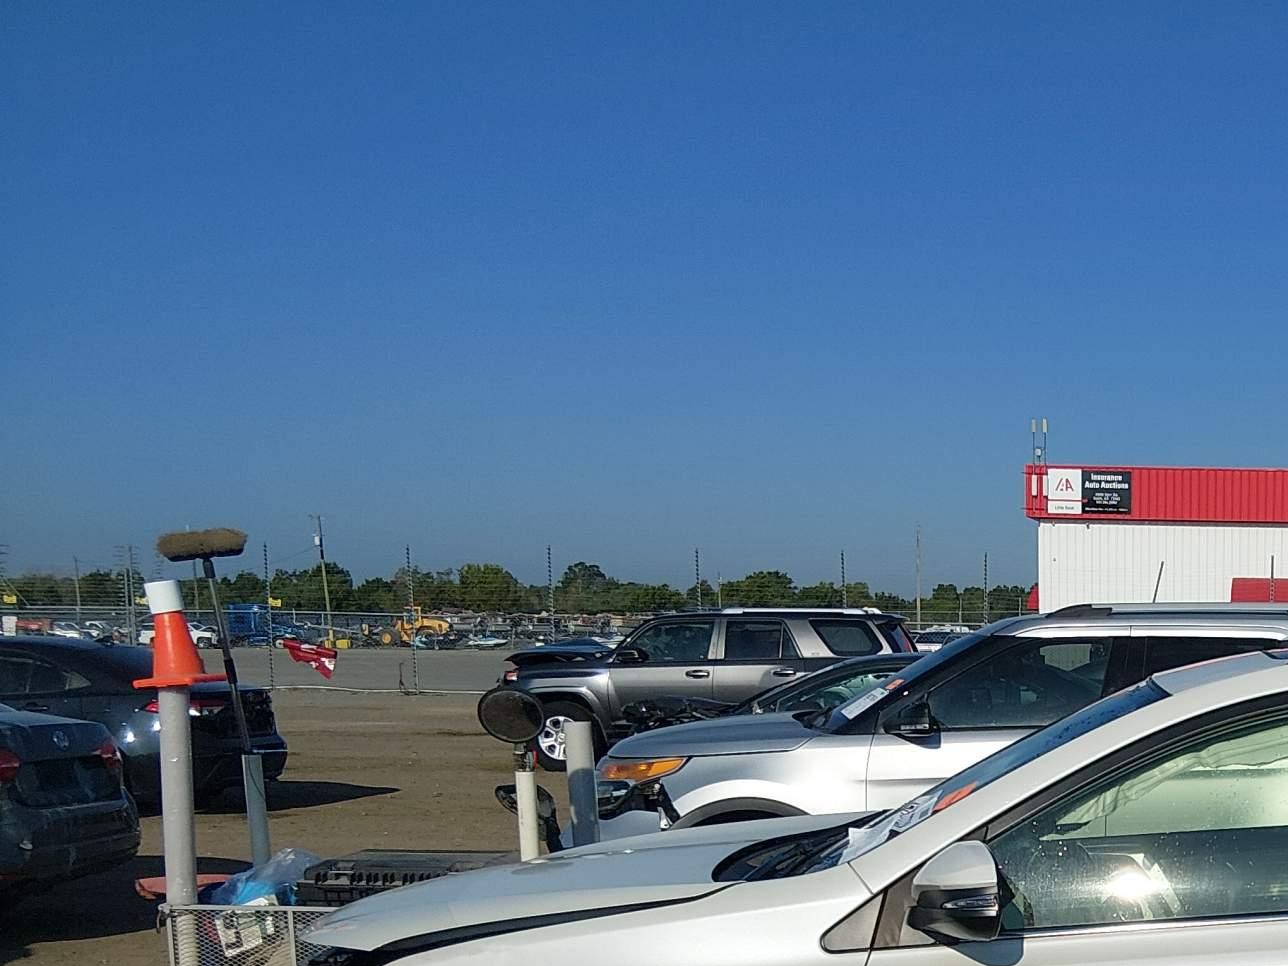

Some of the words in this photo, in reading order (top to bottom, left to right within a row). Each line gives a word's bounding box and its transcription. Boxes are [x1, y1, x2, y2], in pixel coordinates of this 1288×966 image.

[1091, 473, 1122, 481] Insurance
[1085, 481, 1100, 489] Auto
[1101, 481, 1129, 489] Auctions
